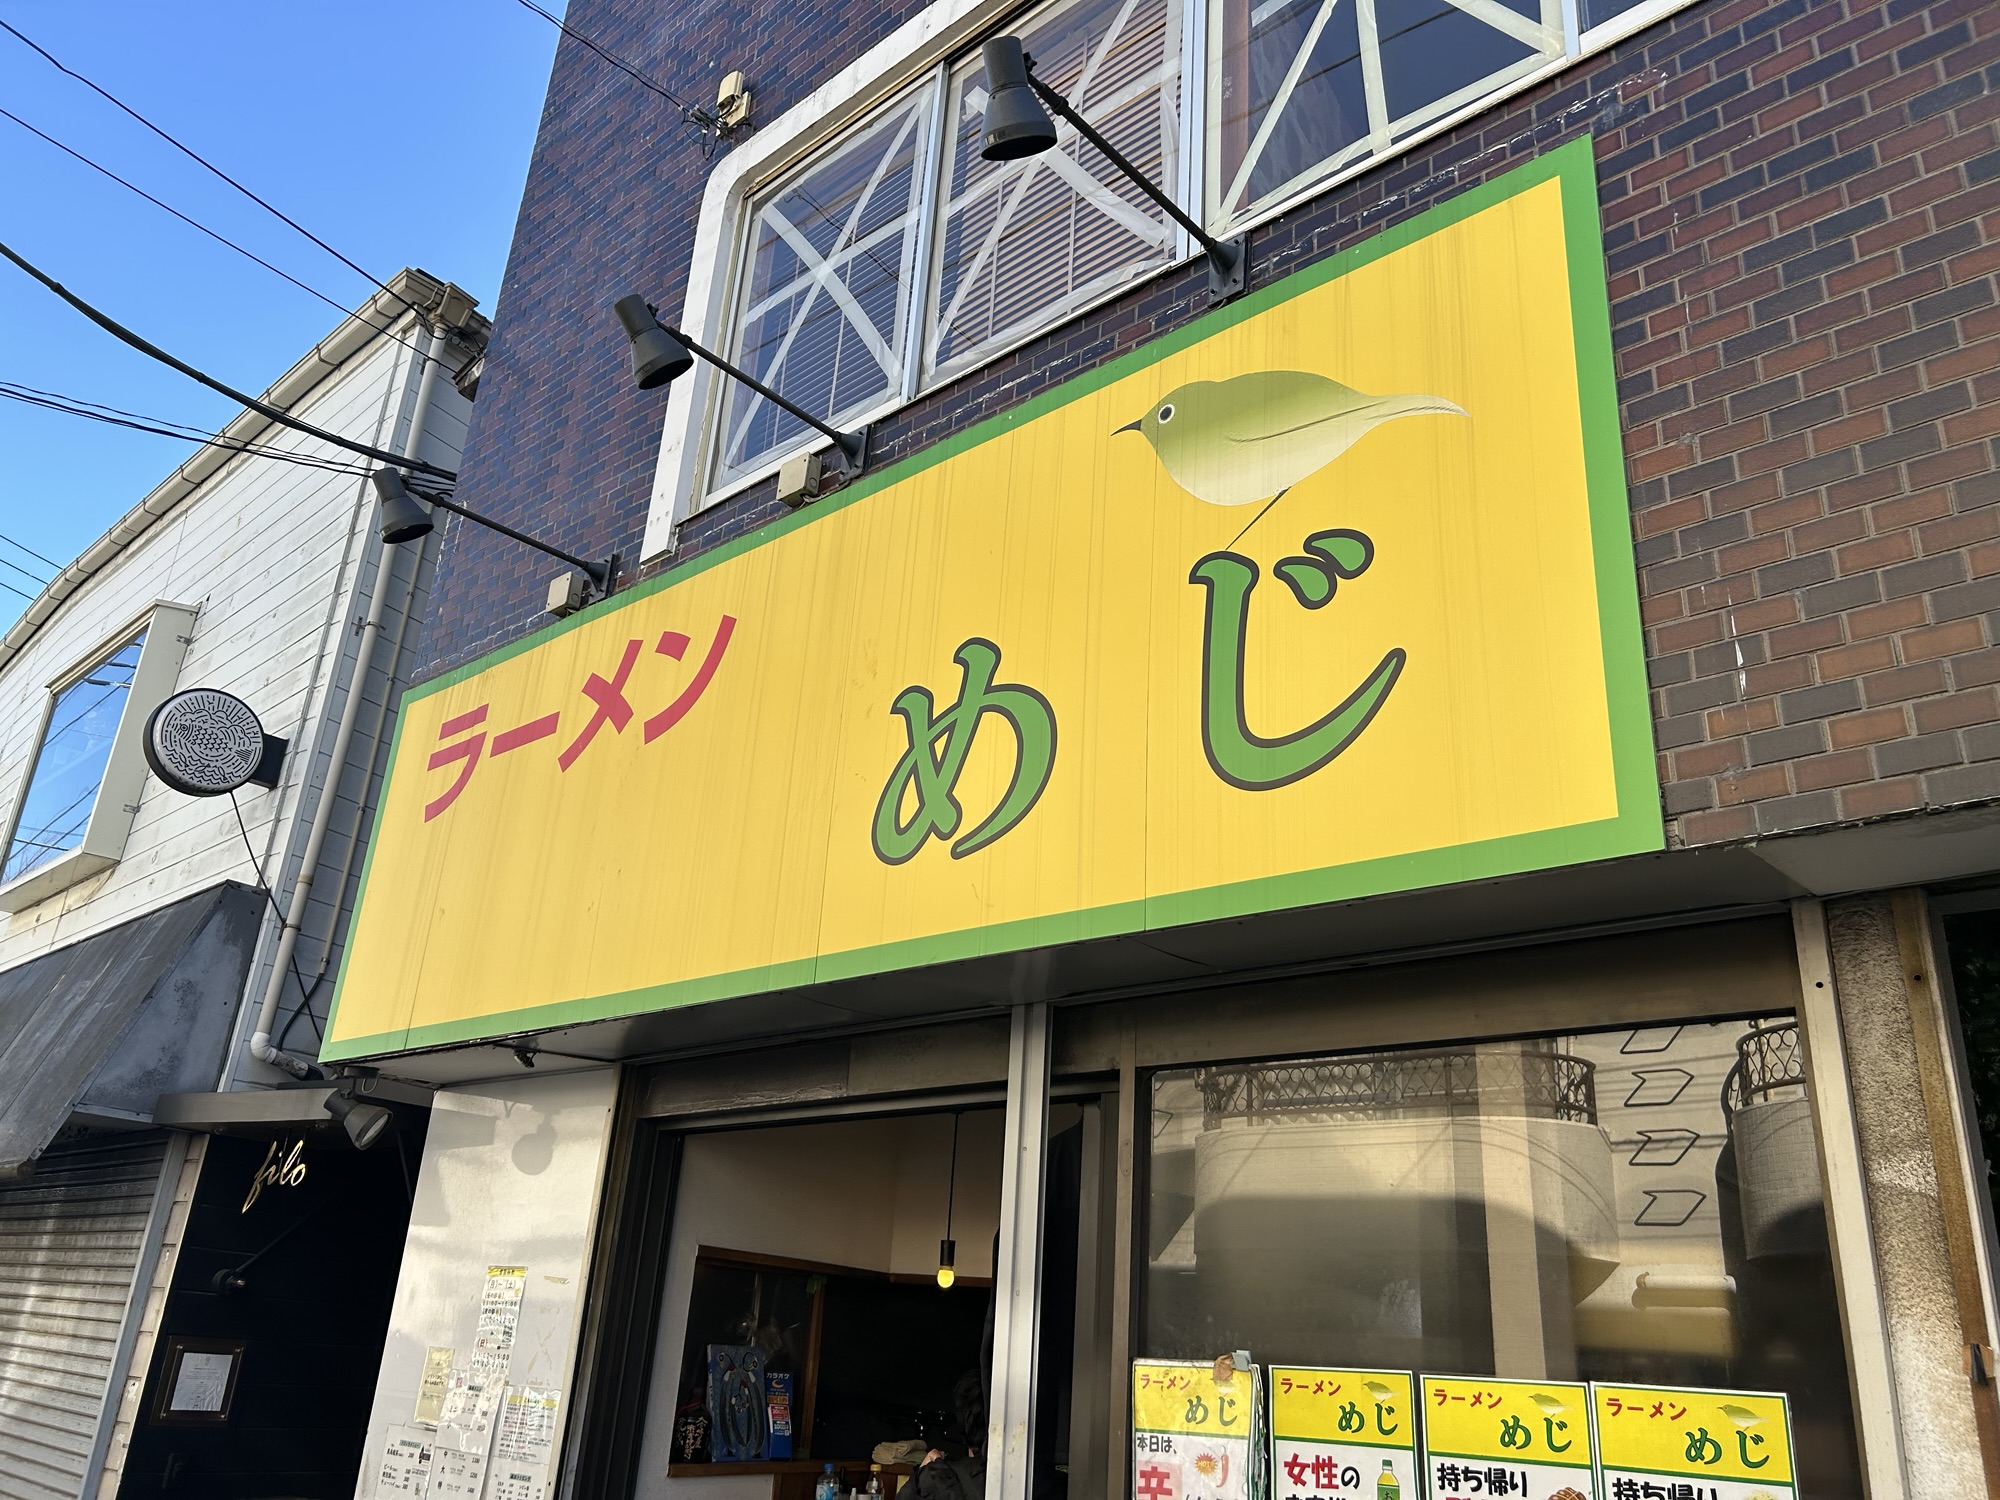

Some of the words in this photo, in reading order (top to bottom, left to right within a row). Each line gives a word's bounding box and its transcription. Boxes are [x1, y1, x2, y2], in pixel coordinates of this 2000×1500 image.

[425, 616, 736, 821] ラーメン
[872, 529, 1407, 866] めじ
[242, 1139, 307, 1214] filo
[1139, 1373, 1192, 1392] ラーメン
[1280, 1377, 1342, 1398] ラーメン
[1433, 1388, 1503, 1410] ラーメン
[1184, 1395, 1238, 1427] めじ
[1337, 1401, 1398, 1436] めじ
[1606, 1397, 1688, 1421] ラーメン
[1137, 1434, 1177, 1454] 本日は、
[1499, 1414, 1573, 1453] めじ
[1685, 1427, 1770, 1469] めじ
[1283, 1452, 1360, 1490] 女性の
[1436, 1462, 1528, 1499] 持ち帰り
